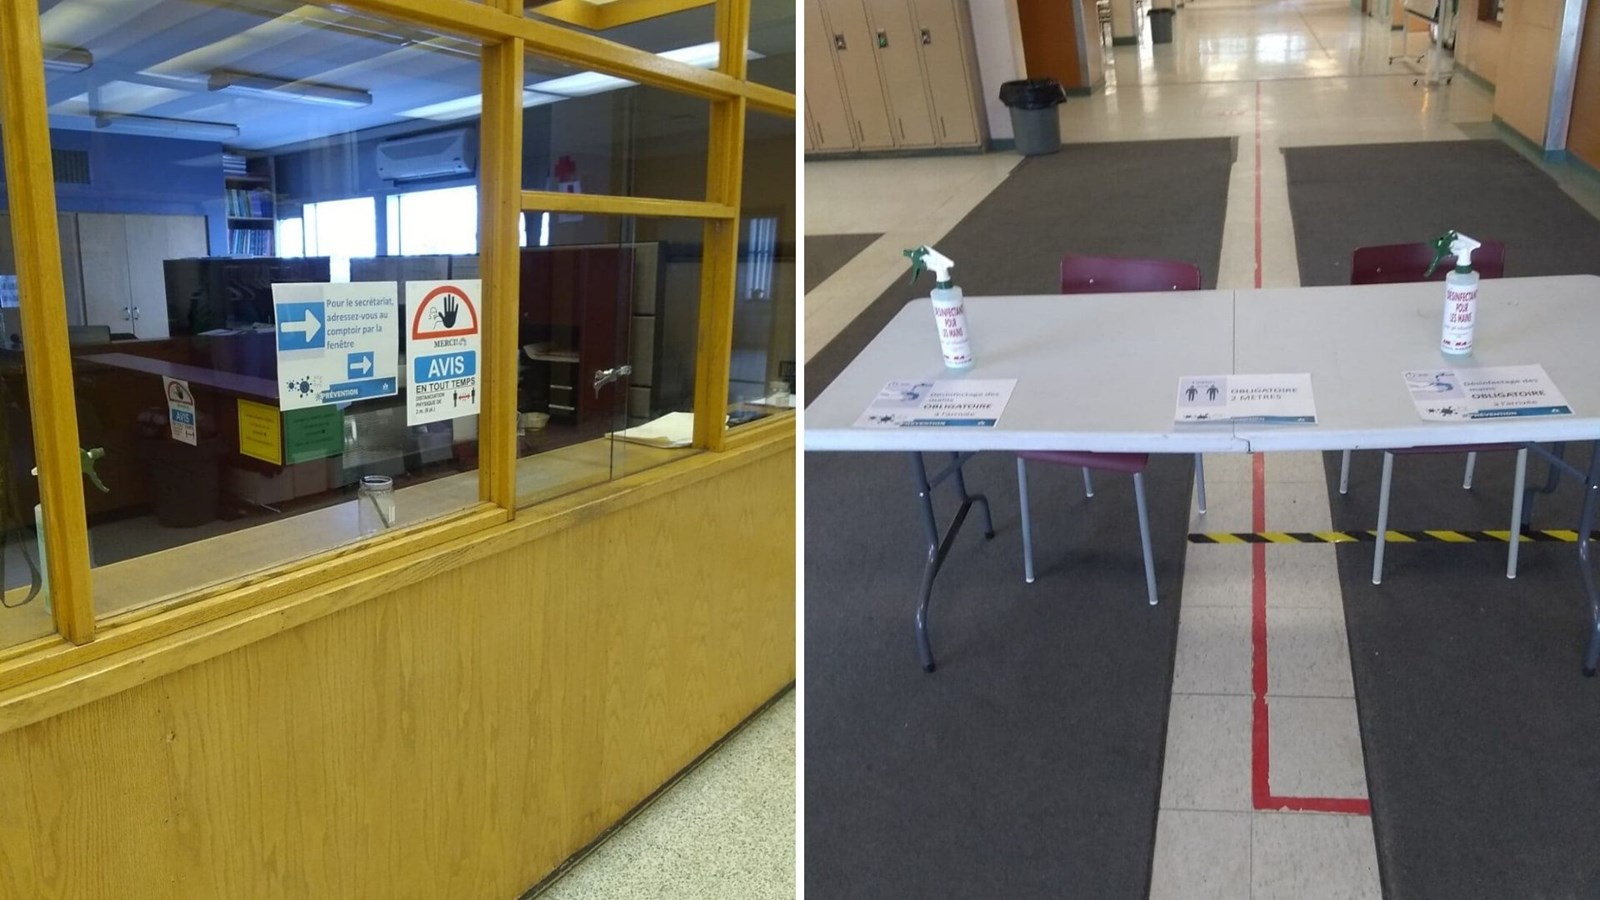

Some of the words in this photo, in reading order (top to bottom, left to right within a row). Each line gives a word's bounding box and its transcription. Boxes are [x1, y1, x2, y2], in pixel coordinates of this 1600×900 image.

[326, 299, 344, 308] Pour
[346, 298, 353, 307] le
[354, 296, 394, 307] secrétariat,
[1456, 303, 1469, 312] POUR
[326, 312, 378, 322] adressez-vous
[326, 325, 361, 336] comptoir
[362, 326, 374, 335] par
[375, 323, 382, 332] la
[326, 340, 355, 349] fenêtre
[428, 355, 465, 378] AVIS
[416, 384, 427, 393] EN
[430, 381, 449, 391] TOUT
[452, 377, 476, 388] TEMPS
[320, 388, 359, 399] PRÉVENTION
[1472, 390, 1546, 399] OBLIGATOIRE
[416, 399, 436, 407] PHYSIQUE
